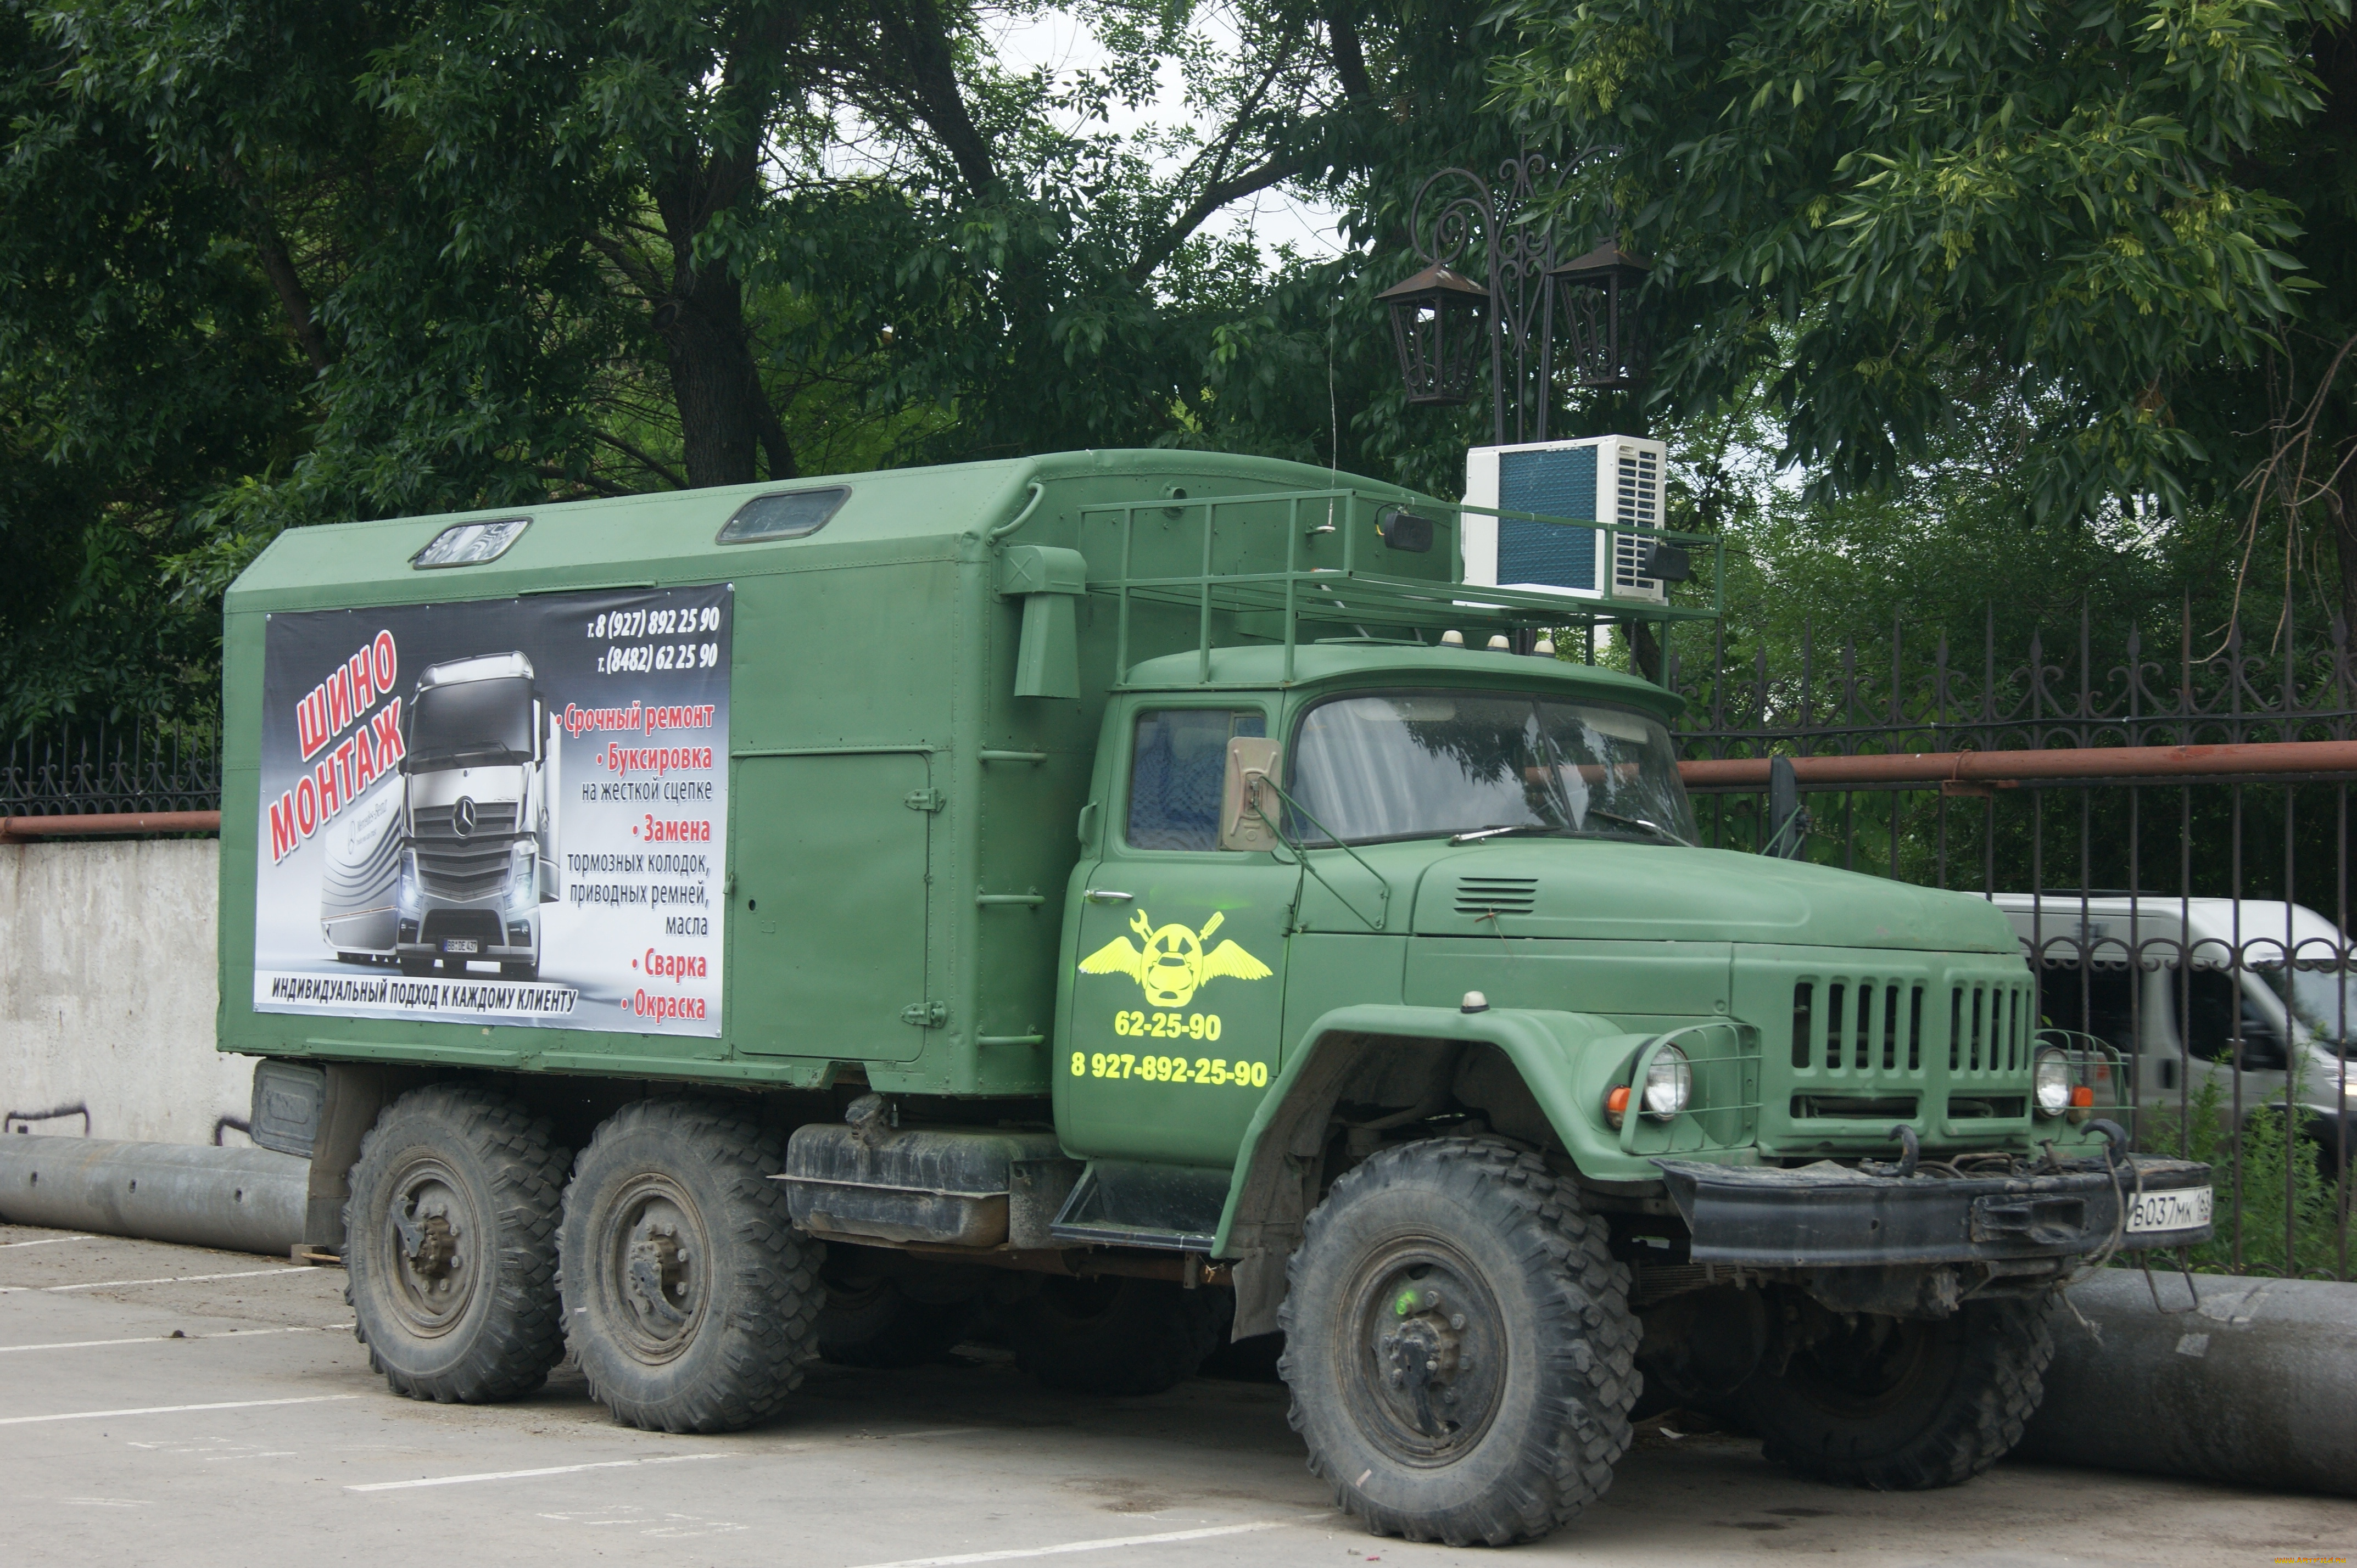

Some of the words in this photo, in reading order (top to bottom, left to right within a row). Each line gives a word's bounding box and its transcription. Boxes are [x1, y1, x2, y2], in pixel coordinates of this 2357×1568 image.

[595, 614, 606, 637] 8
[608, 609, 646, 639] (927)
[648, 609, 676, 635] 892
[678, 609, 697, 632] 25
[700, 607, 720, 631] 90
[607, 644, 653, 674] (8482)
[656, 646, 674, 669] 62
[676, 645, 696, 668] 25
[700, 643, 718, 667] 90
[297, 630, 396, 762] ШИНО
[565, 701, 641, 738] Срочный
[646, 705, 714, 736] ремонт
[608, 742, 712, 777] Буксировка
[269, 696, 406, 865] МОНТАЖ
[582, 783, 596, 801] на
[601, 776, 659, 800] жесткой
[664, 781, 712, 805] сцепке
[644, 814, 710, 842] Замена
[568, 854, 643, 877] тормозных
[648, 855, 710, 876] колодок,
[571, 884, 646, 907] приводных
[652, 881, 709, 909] ремней,
[666, 916, 707, 935] масла
[645, 948, 706, 983] Сварка
[272, 978, 387, 1004] ИНДИВИДУАЛЬНЫЙ
[390, 983, 438, 1009] ПОДХОД
[442, 985, 449, 1006] К
[452, 986, 515, 1012] КАЖДОМУ
[517, 989, 577, 1012] КЛИЕНТУ
[634, 988, 706, 1024] Окраска
[1115, 1011, 1221, 1040] 62-25-90
[1071, 1052, 1085, 1076] 8
[1092, 1053, 1267, 1087] 927-892-25-90
